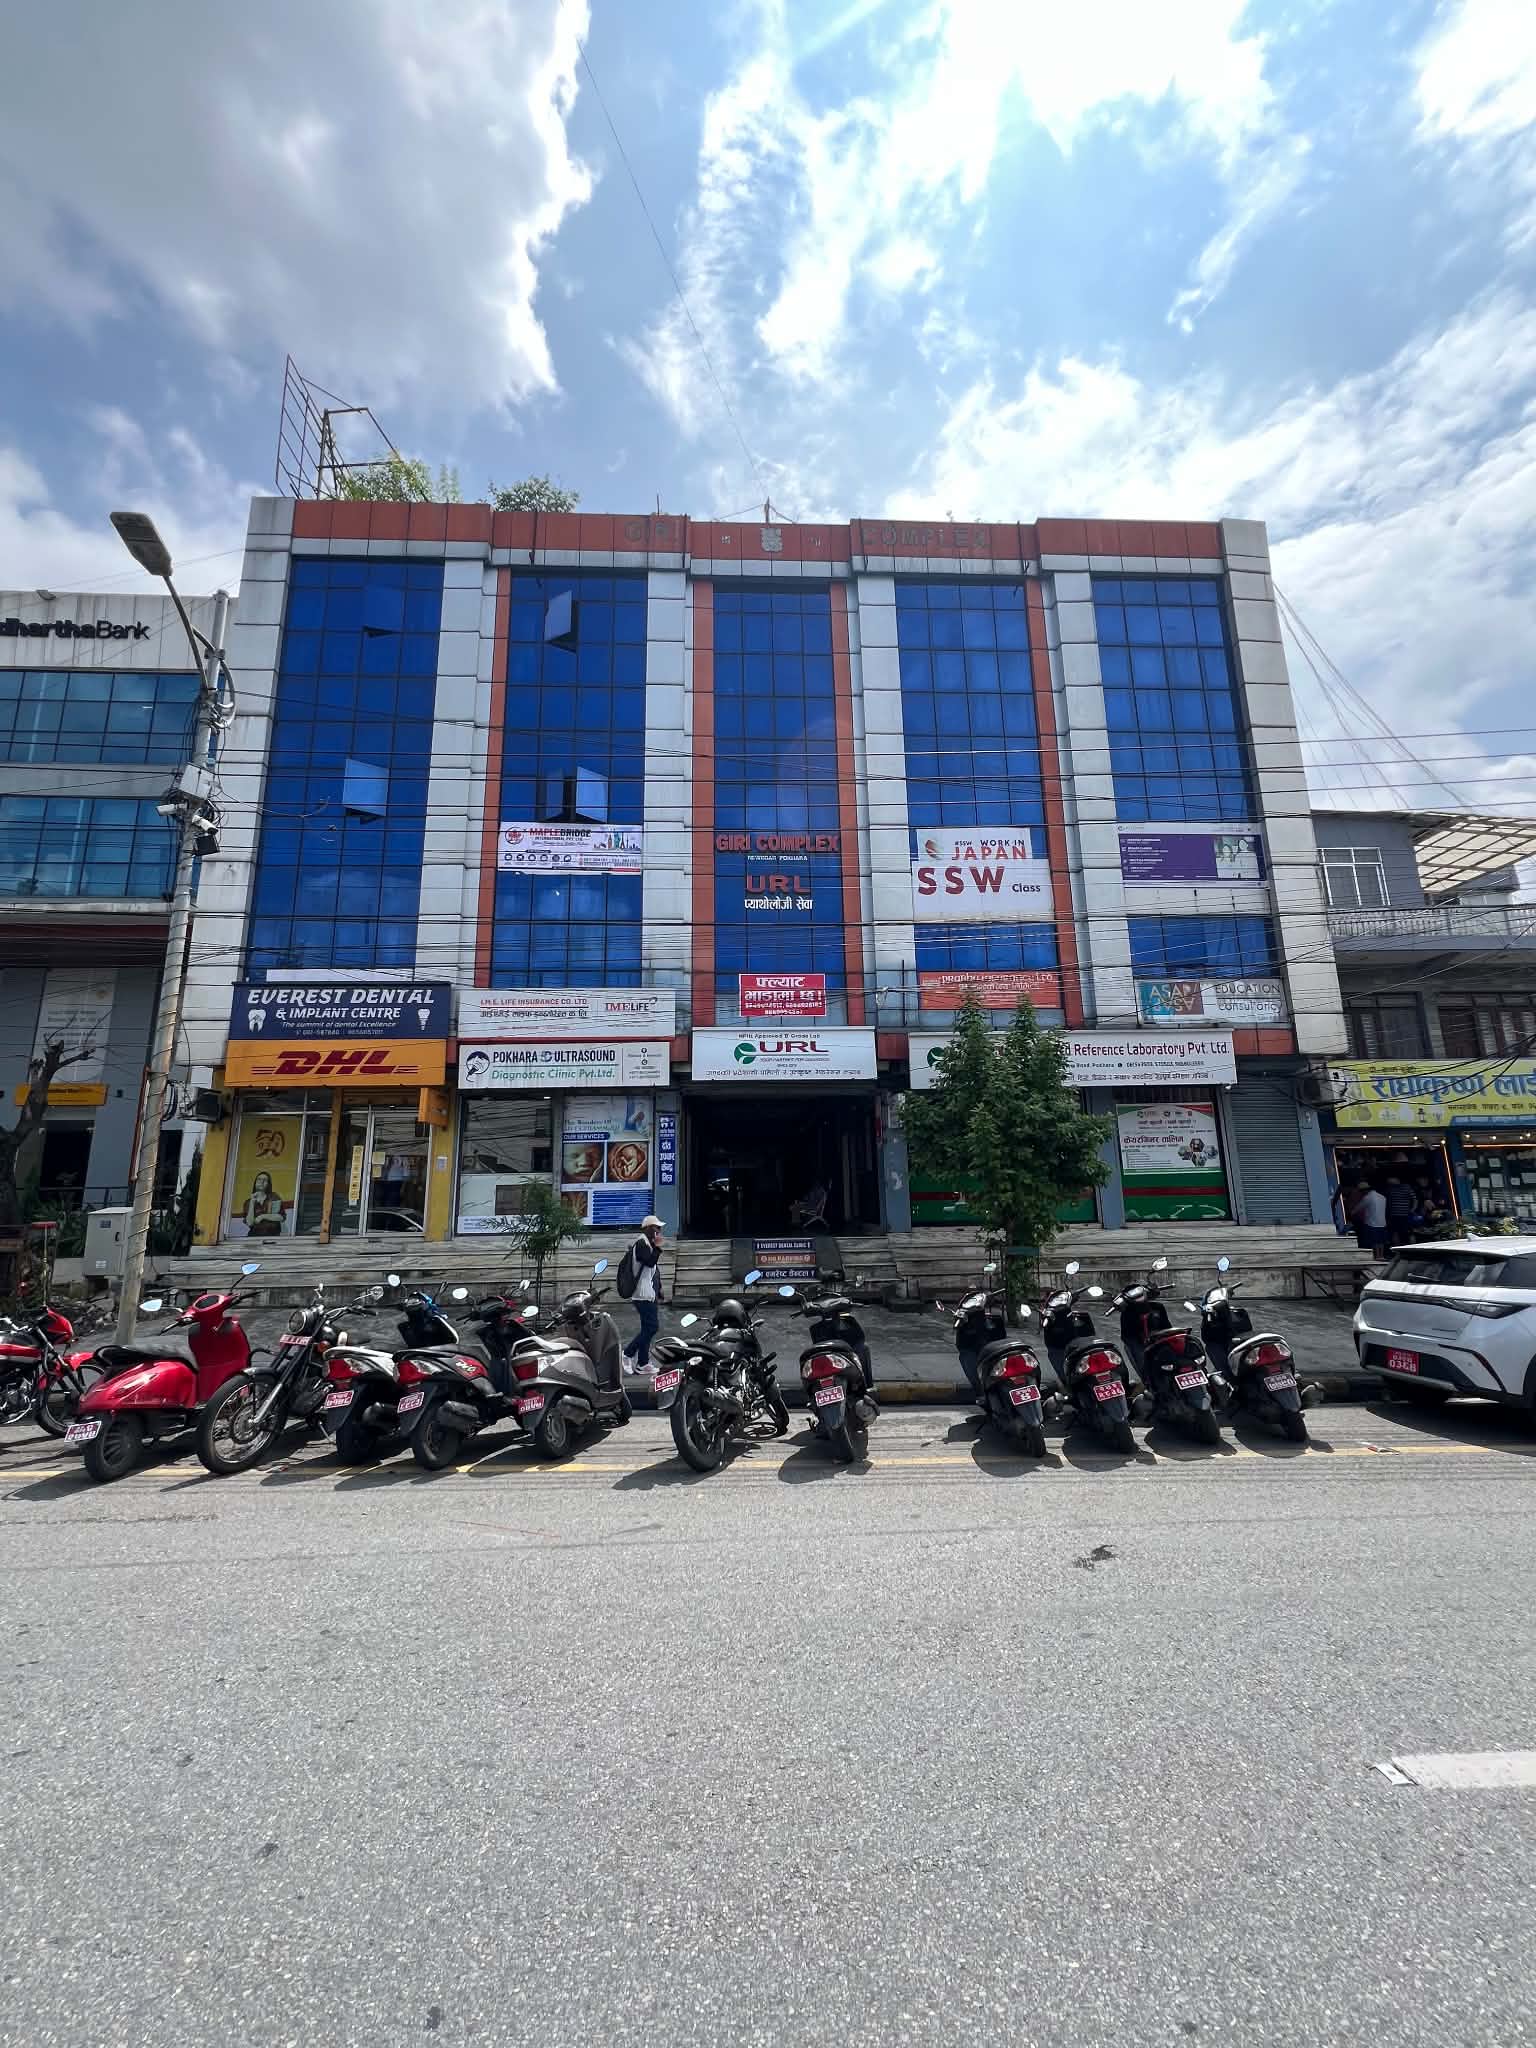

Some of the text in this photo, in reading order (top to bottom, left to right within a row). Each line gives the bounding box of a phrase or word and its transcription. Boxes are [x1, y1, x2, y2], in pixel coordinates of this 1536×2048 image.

[716, 834, 839, 851] GIRI COMPLEX
[952, 846, 1026, 860] JAPAN
[746, 874, 811, 893] URL
[917, 866, 1041, 895] SSW Class
[796, 896, 814, 911] सेवा
[1215, 983, 1280, 995] EDUCATION
[248, 989, 435, 1007] EVEREST DENTAL
[275, 1007, 401, 1020] & IMPLANT CENTRE
[759, 1041, 829, 1053] URL
[1074, 1043, 1124, 1056] Reference
[1127, 1043, 1184, 1057] Laboratory
[1187, 1042, 1208, 1055] Pvt.
[1210, 1042, 1230, 1054] Ltd.
[273, 1050, 396, 1074] DHL
[493, 1051, 538, 1063] POKHARA
[554, 1050, 616, 1062] ULTRASOUND
[491, 1068, 546, 1081] Diagnostic
[548, 1068, 576, 1079] Clinic
